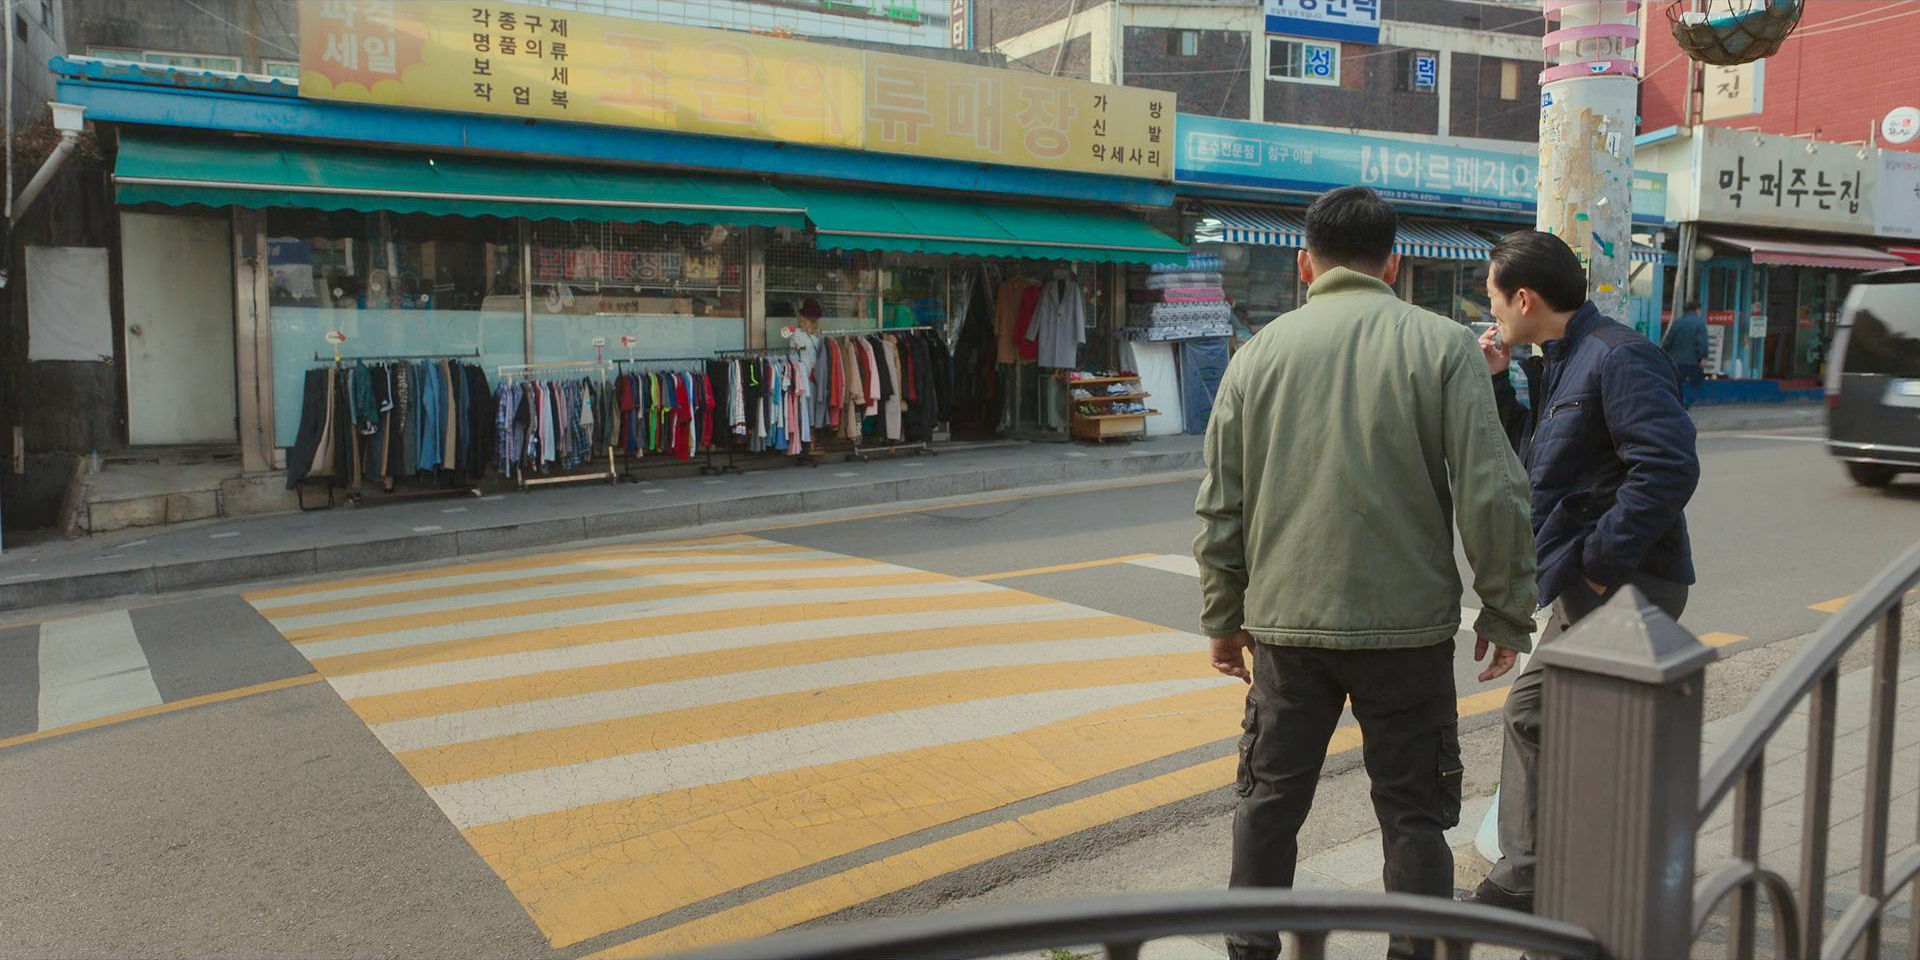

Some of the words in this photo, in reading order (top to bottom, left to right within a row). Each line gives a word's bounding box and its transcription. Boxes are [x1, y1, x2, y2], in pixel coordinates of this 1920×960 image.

[321, 31, 397, 74] 세일
[1309, 47, 1331, 77] 성
[1416, 56, 1436, 85] 력
[1092, 144, 1160, 167] 악세사리
